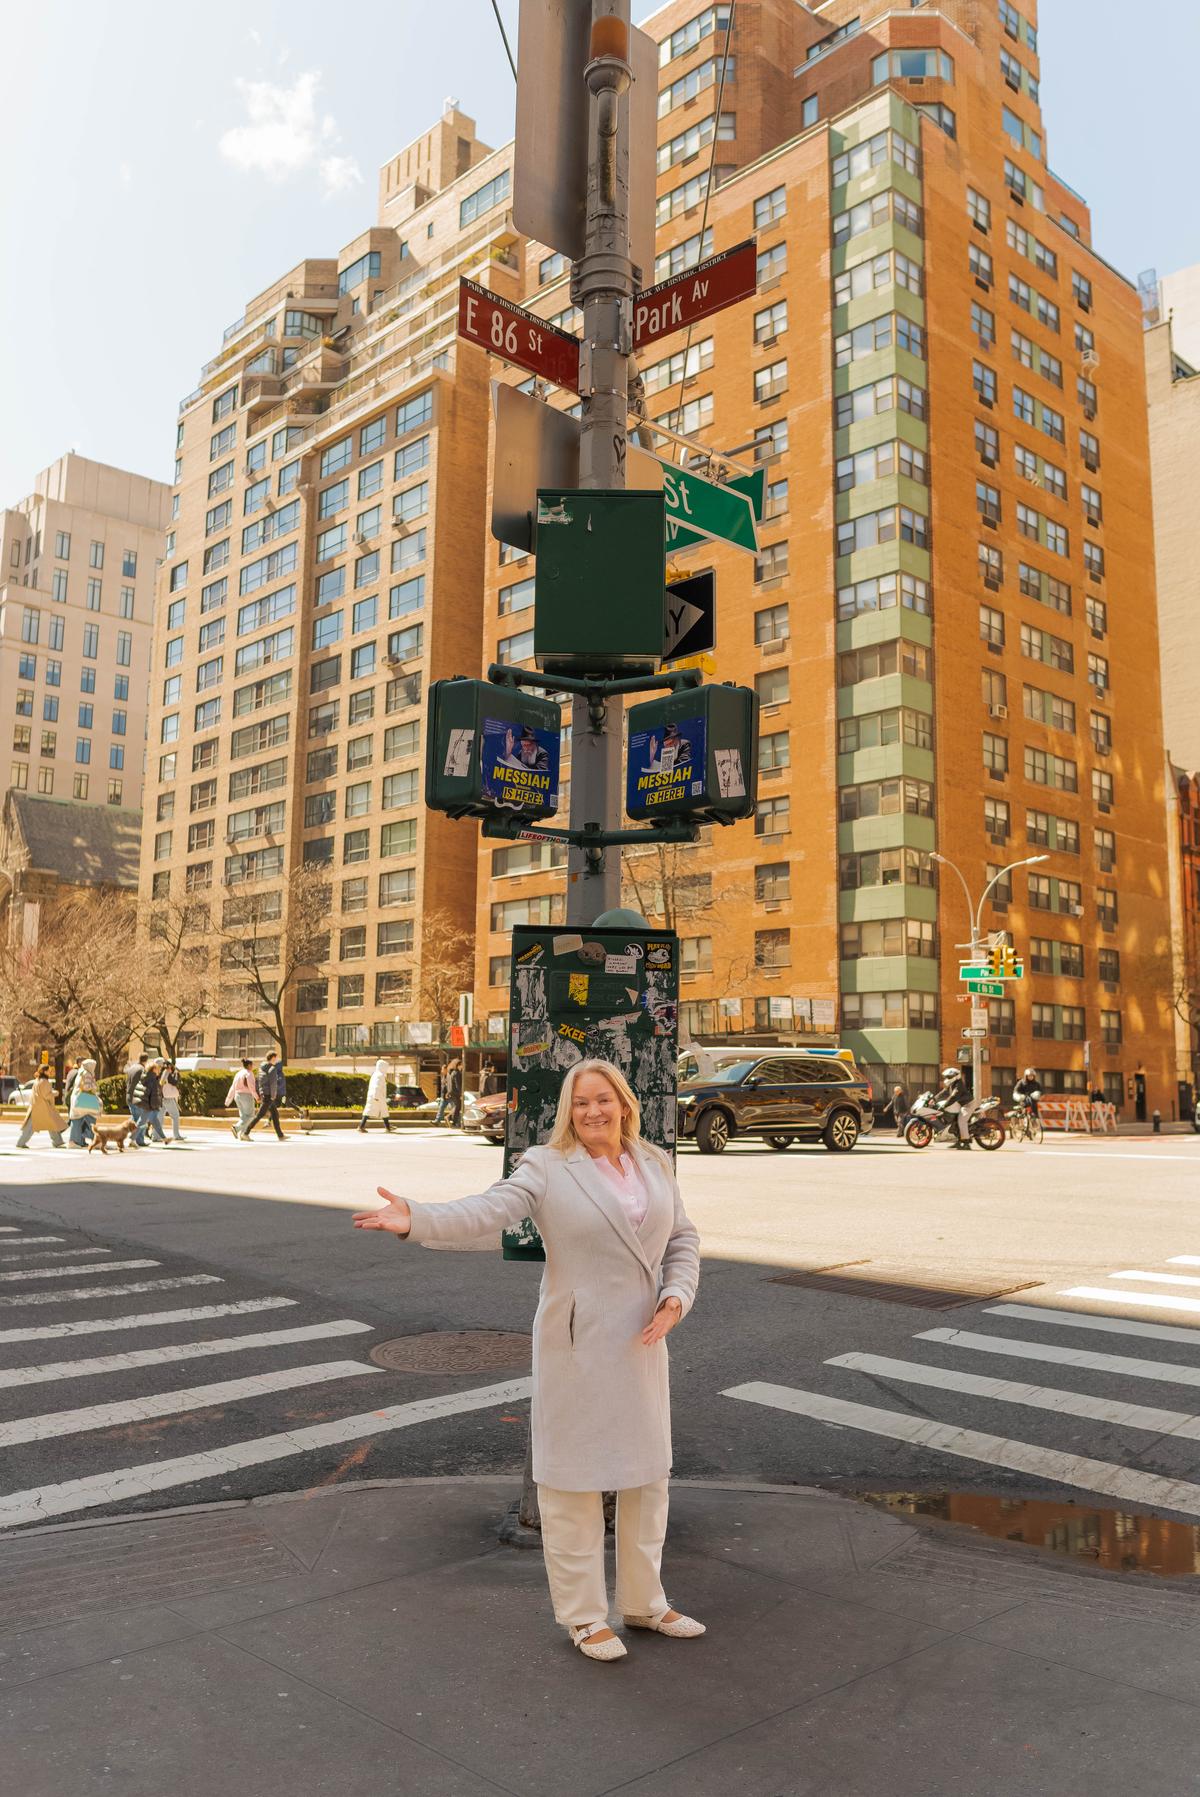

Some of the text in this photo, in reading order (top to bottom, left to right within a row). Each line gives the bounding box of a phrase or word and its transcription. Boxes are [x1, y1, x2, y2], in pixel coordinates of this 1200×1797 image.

[636, 289, 653, 302] PARK
[667, 269, 697, 288] HISTORIC
[698, 252, 728, 271] DISTRICT
[467, 280, 557, 333] PARK AVE HISTORIC DISTRICT
[636, 280, 709, 341] Park Av
[466, 296, 543, 355] E 86 St
[663, 472, 693, 515] St
[493, 766, 551, 791] MESSIAH
[637, 766, 693, 791] MESSIAH
[647, 792, 656, 805] IS
[657, 786, 685, 802] HERE!
[503, 787, 544, 806] IS HERE!
[558, 1023, 587, 1043] ZKEE
